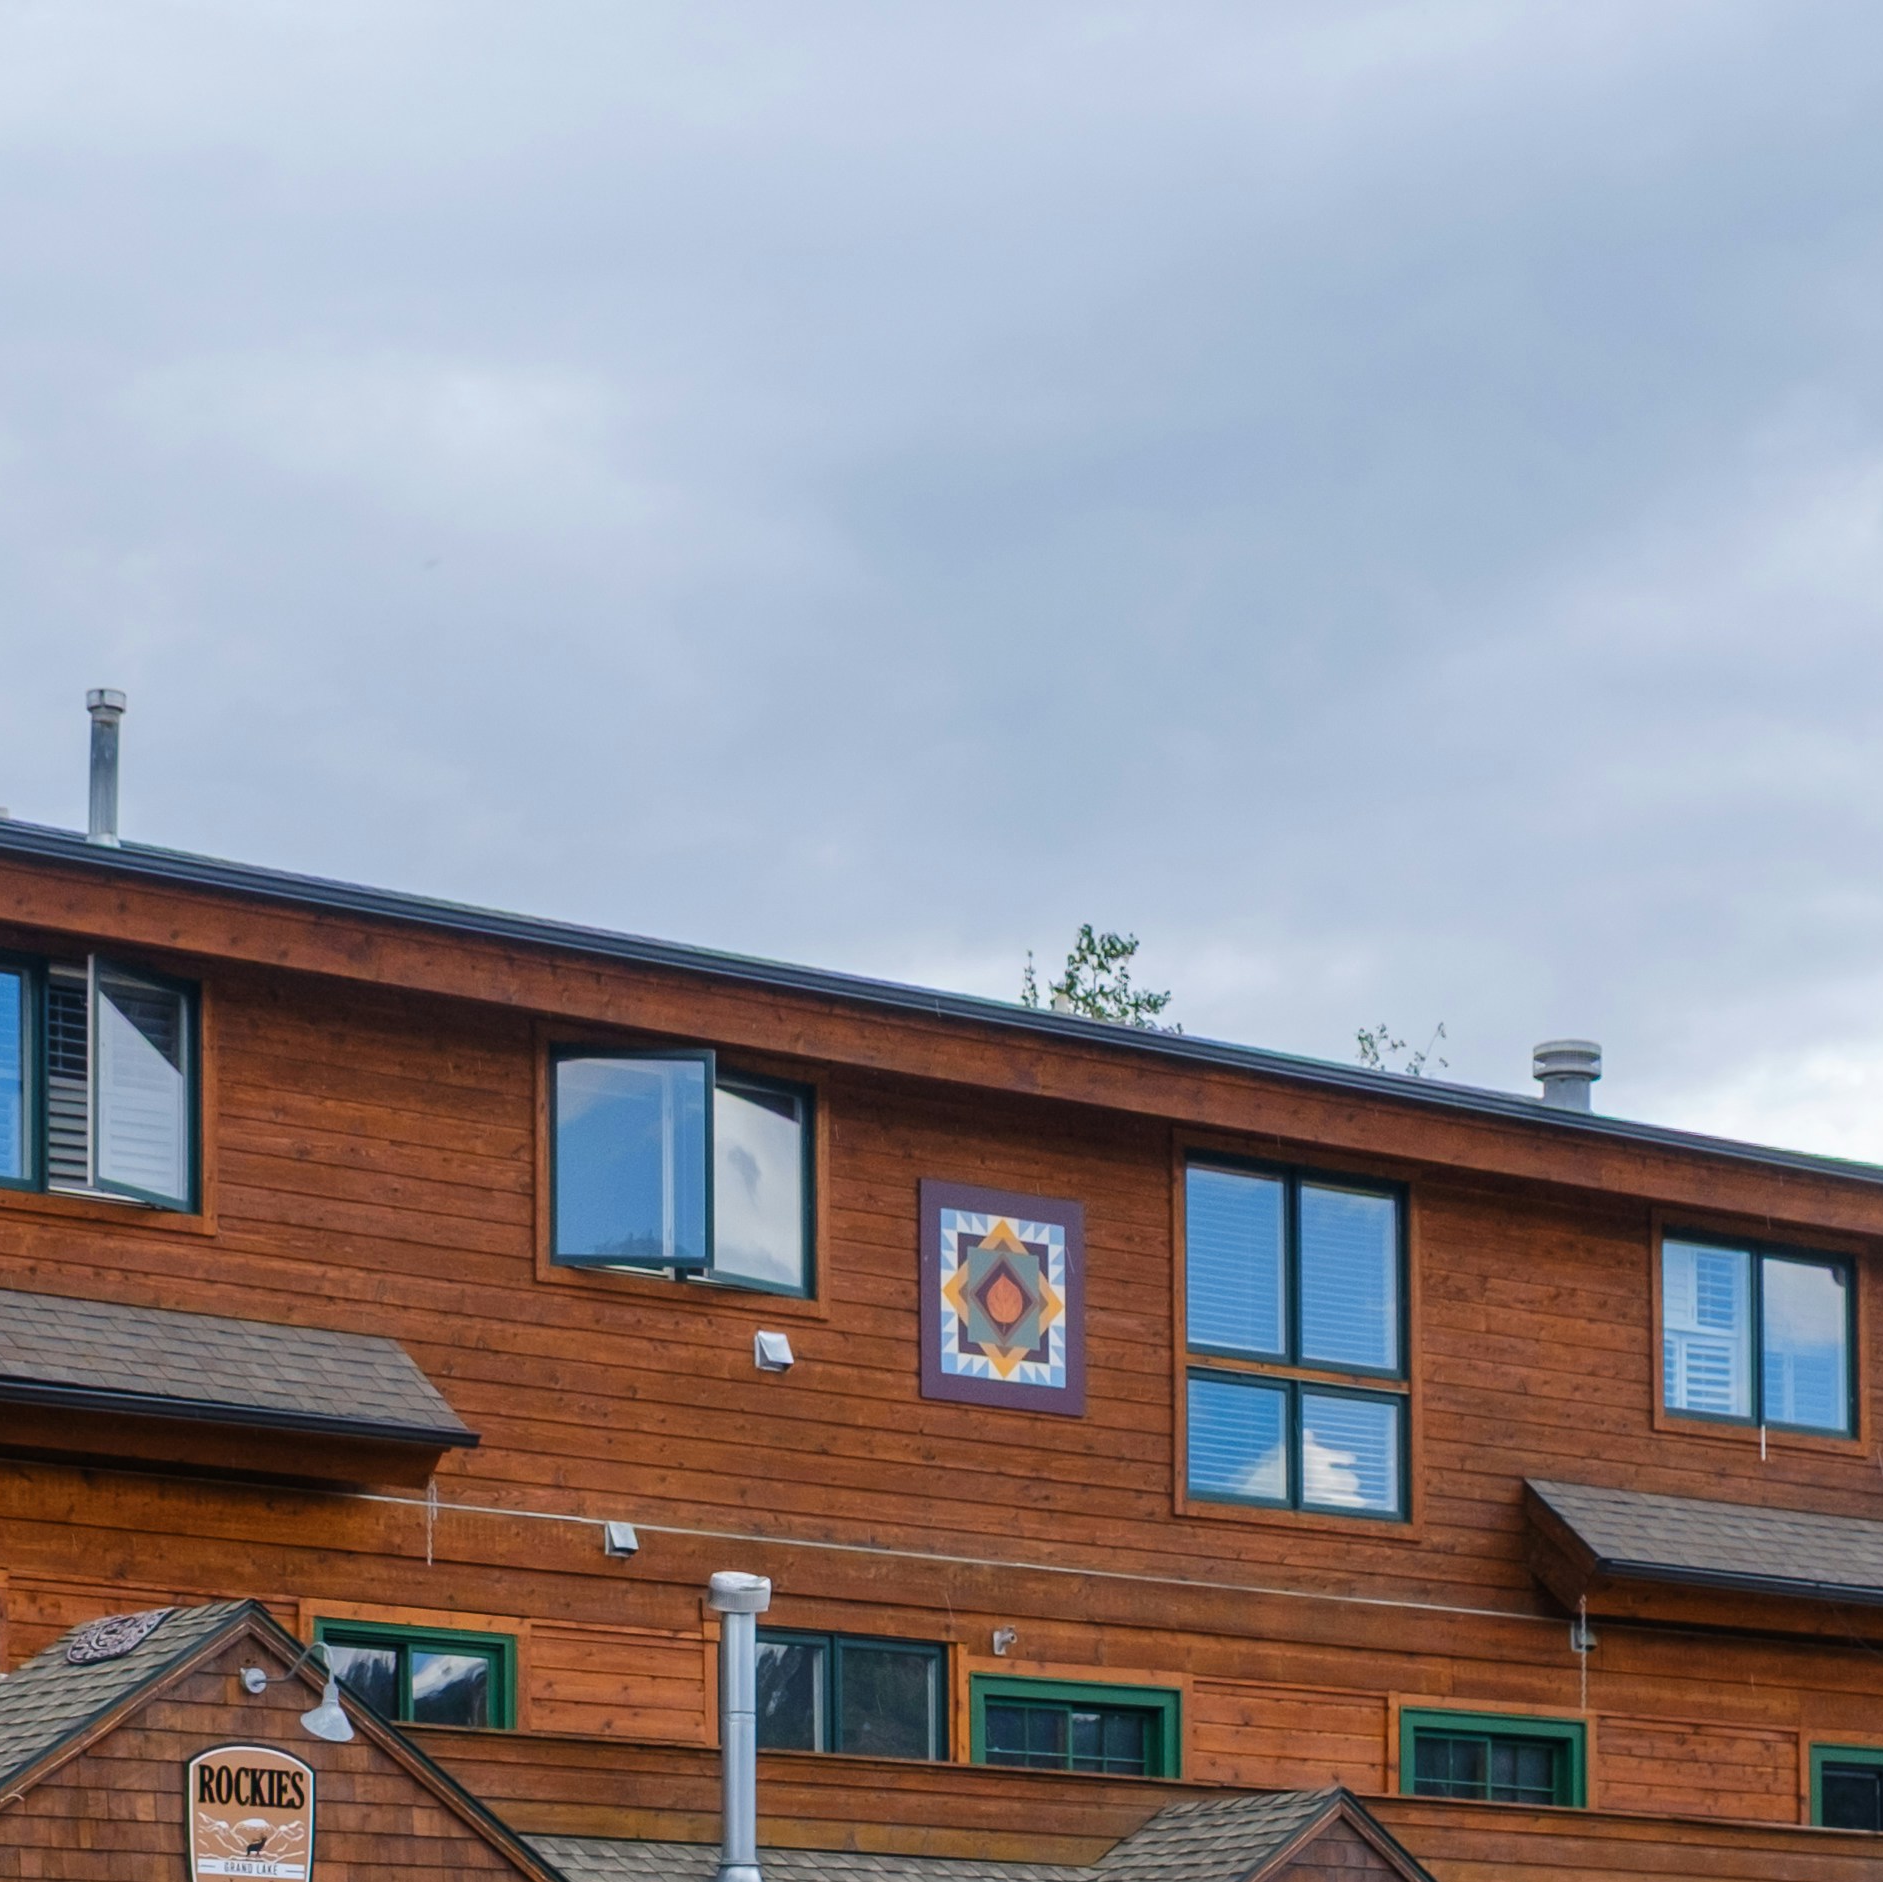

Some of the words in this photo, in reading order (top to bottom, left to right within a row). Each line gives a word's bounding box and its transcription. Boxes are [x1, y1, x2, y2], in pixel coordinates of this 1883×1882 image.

[198, 1764, 305, 1810] ROCKIES
[224, 1862, 253, 1874] GRAND
[256, 1863, 278, 1876] LAKE
